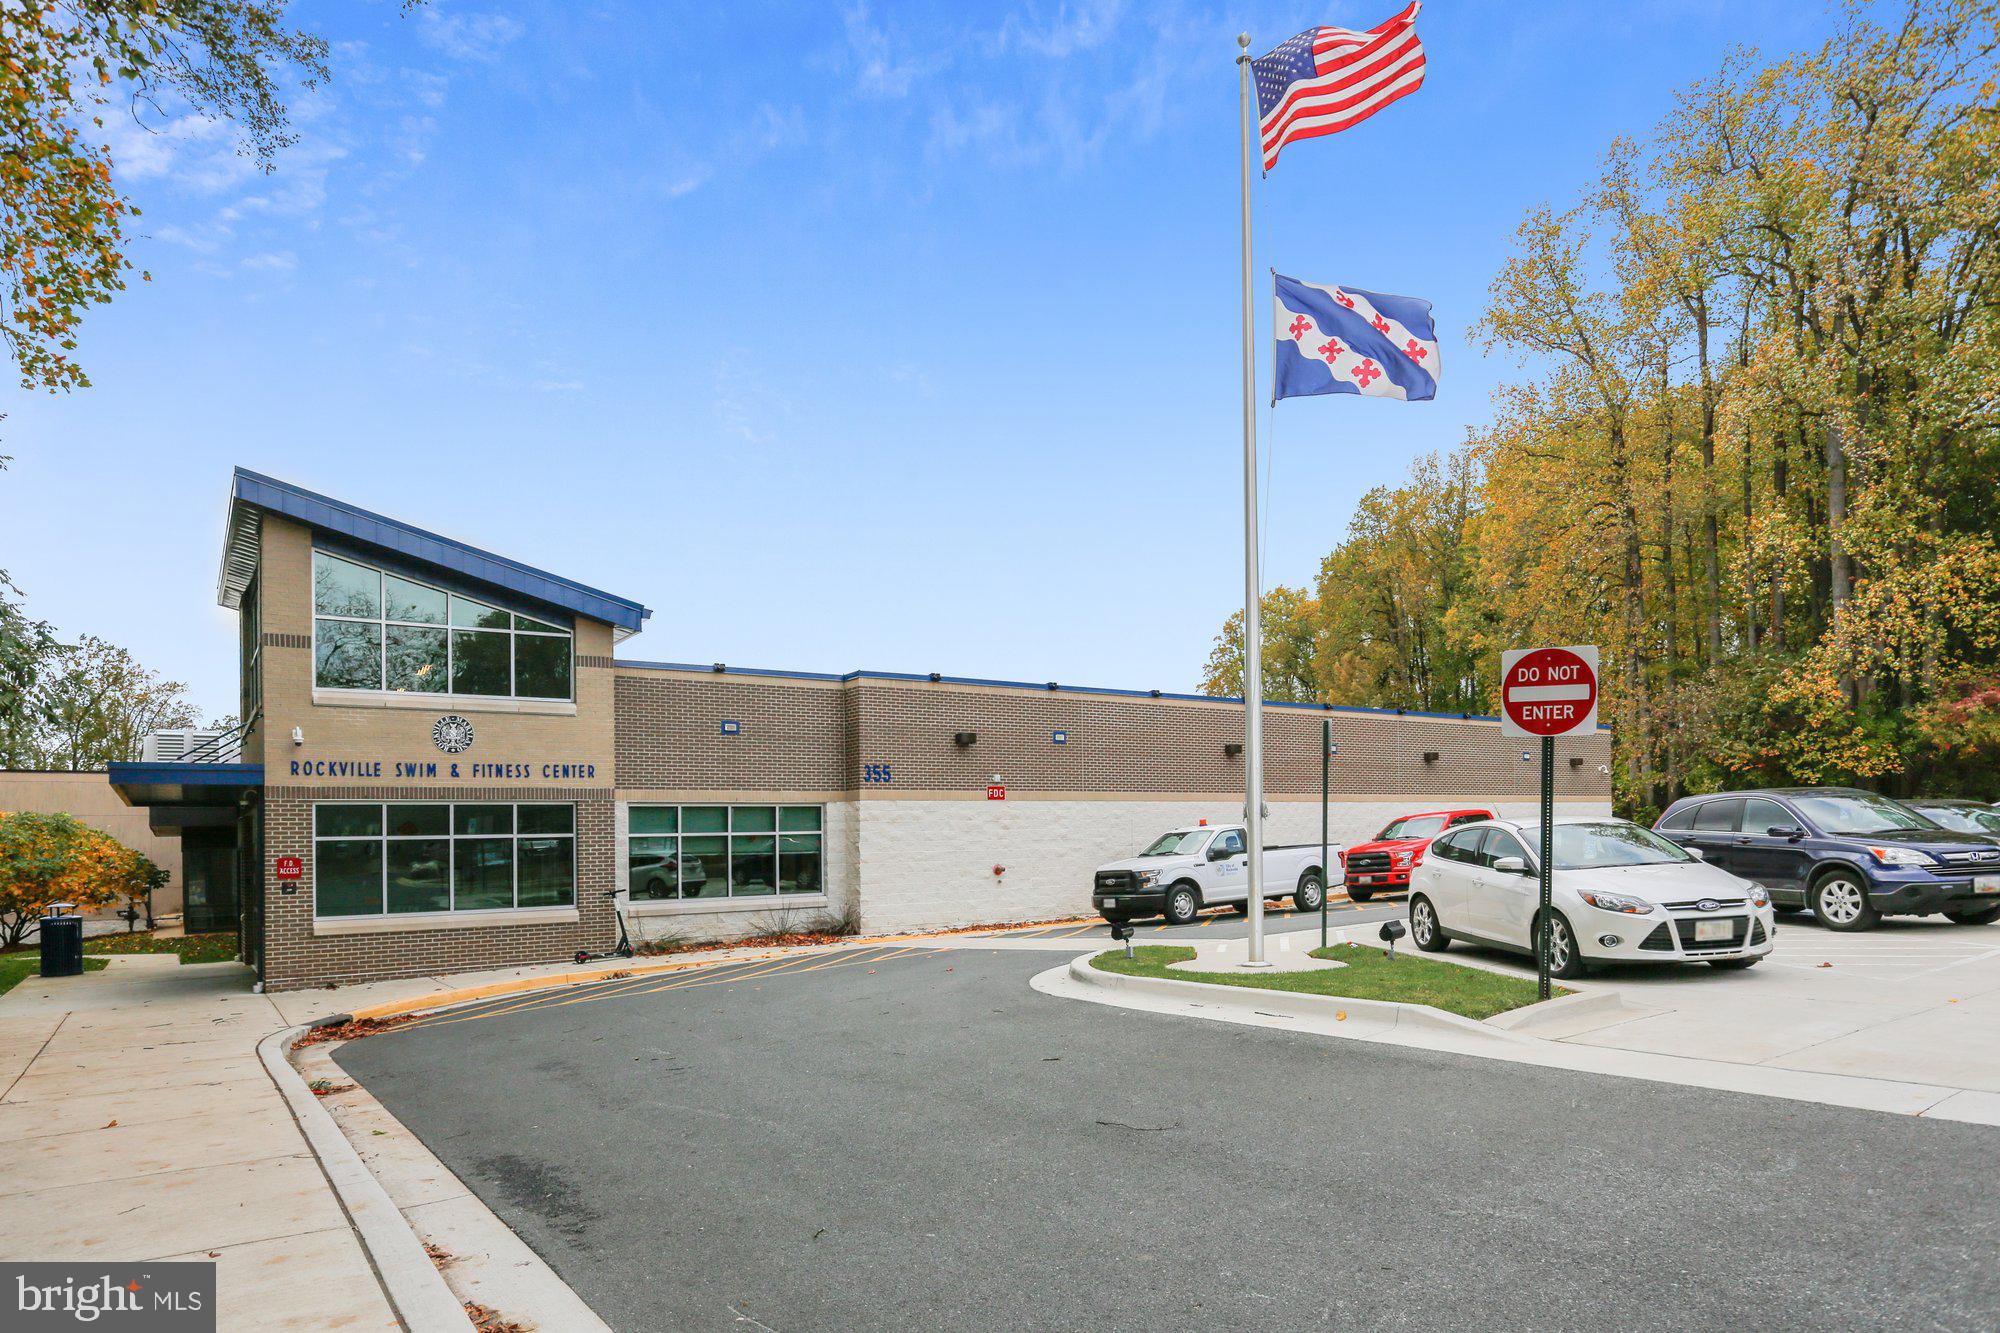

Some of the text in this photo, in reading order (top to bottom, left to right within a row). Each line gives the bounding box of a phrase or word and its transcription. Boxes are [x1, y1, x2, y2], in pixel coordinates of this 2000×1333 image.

[1518, 665, 1580, 682] DO NOT
[1522, 705, 1575, 720] ENTER
[291, 760, 596, 779] ROCKVILLE SWIM & FITNESS CENTER
[863, 763, 891, 783] 355
[988, 787, 1004, 798] FDC
